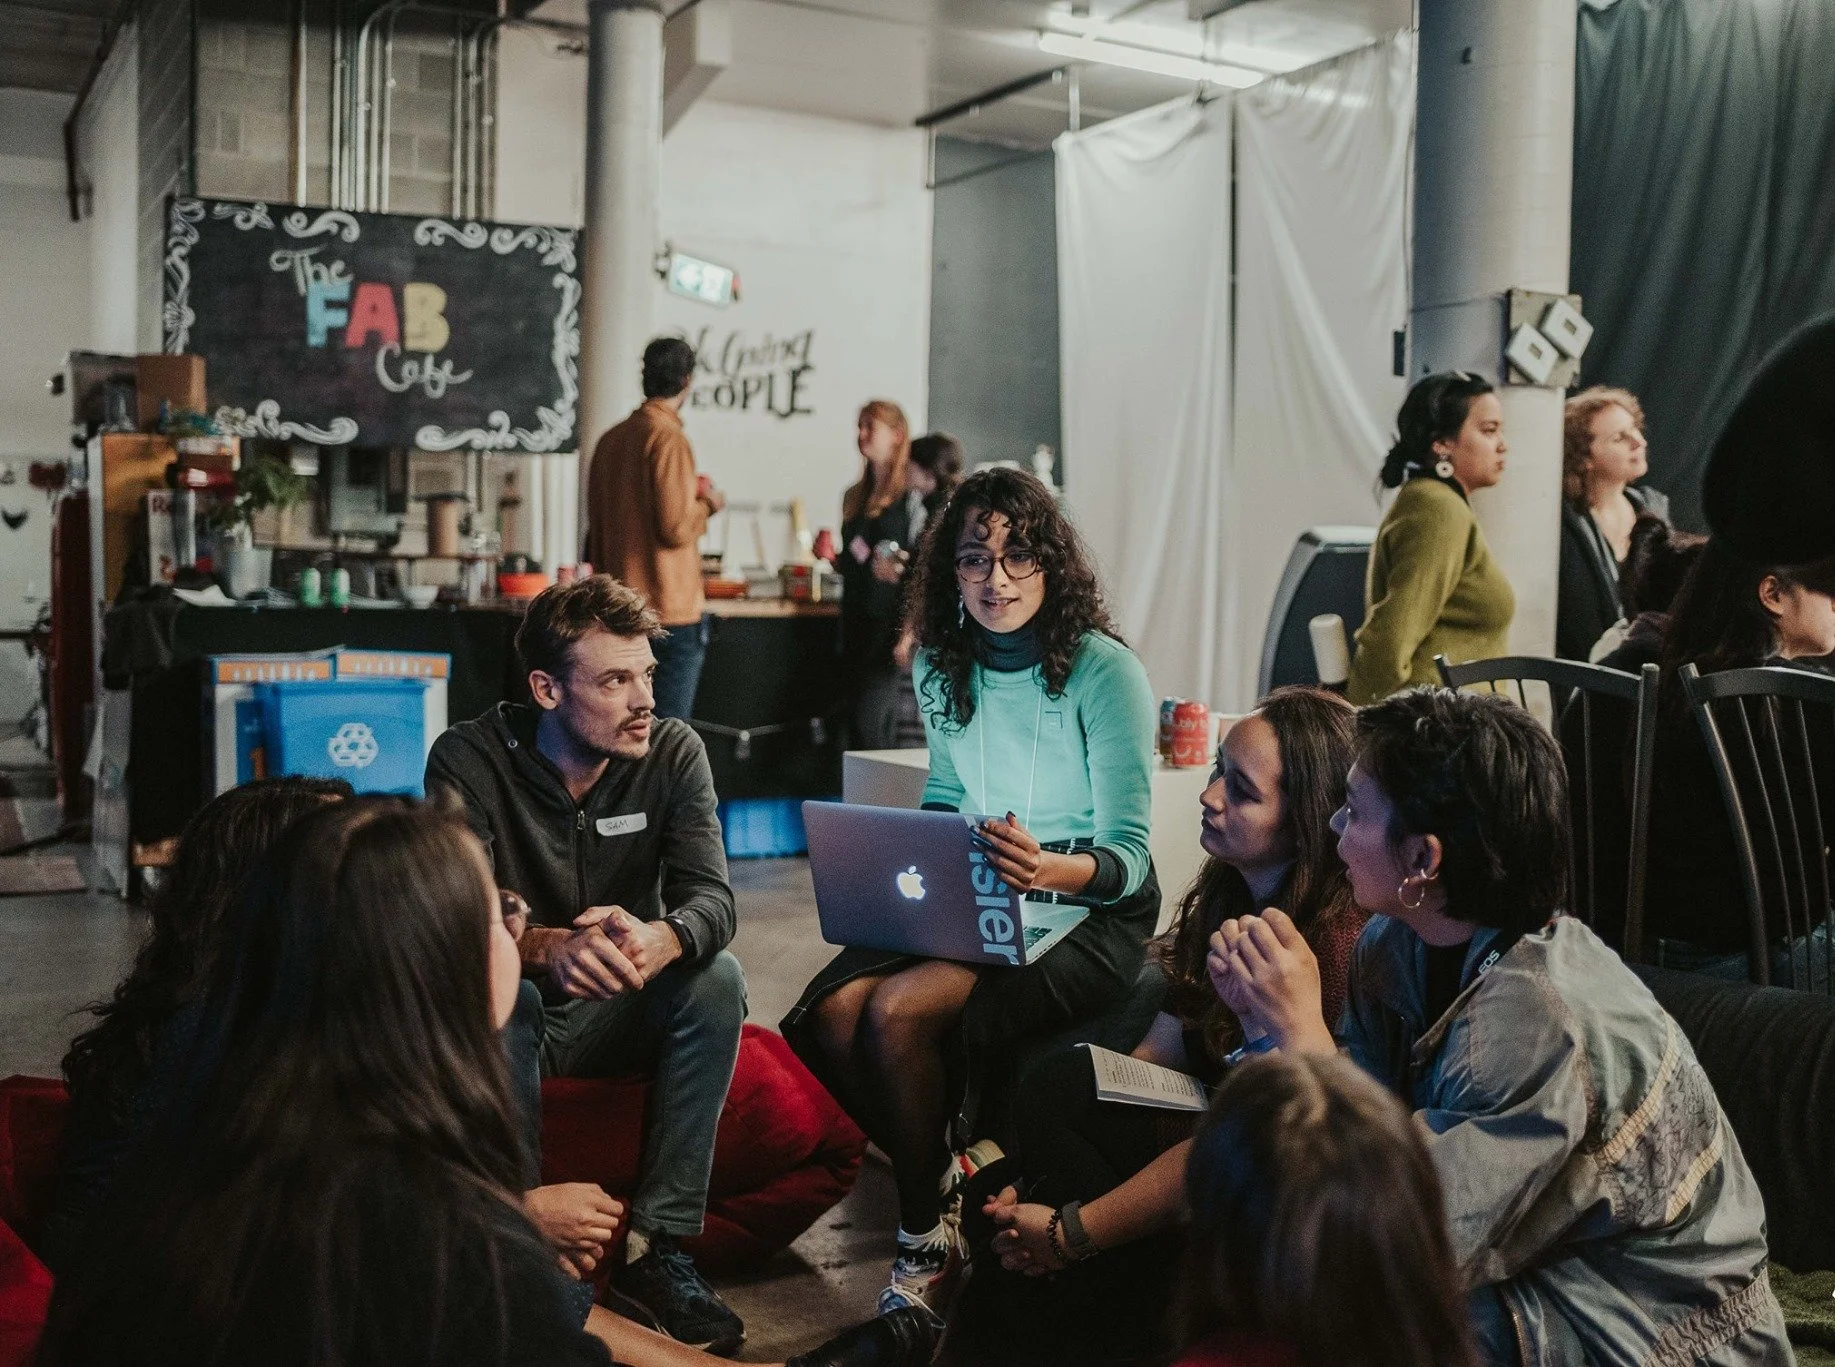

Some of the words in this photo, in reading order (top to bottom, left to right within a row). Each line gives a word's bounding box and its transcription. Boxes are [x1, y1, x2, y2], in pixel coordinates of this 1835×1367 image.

[269, 244, 354, 296] The
[306, 281, 450, 353] FAB
[690, 363, 815, 420] EOPLE
[1478, 949, 1500, 974] EOS
